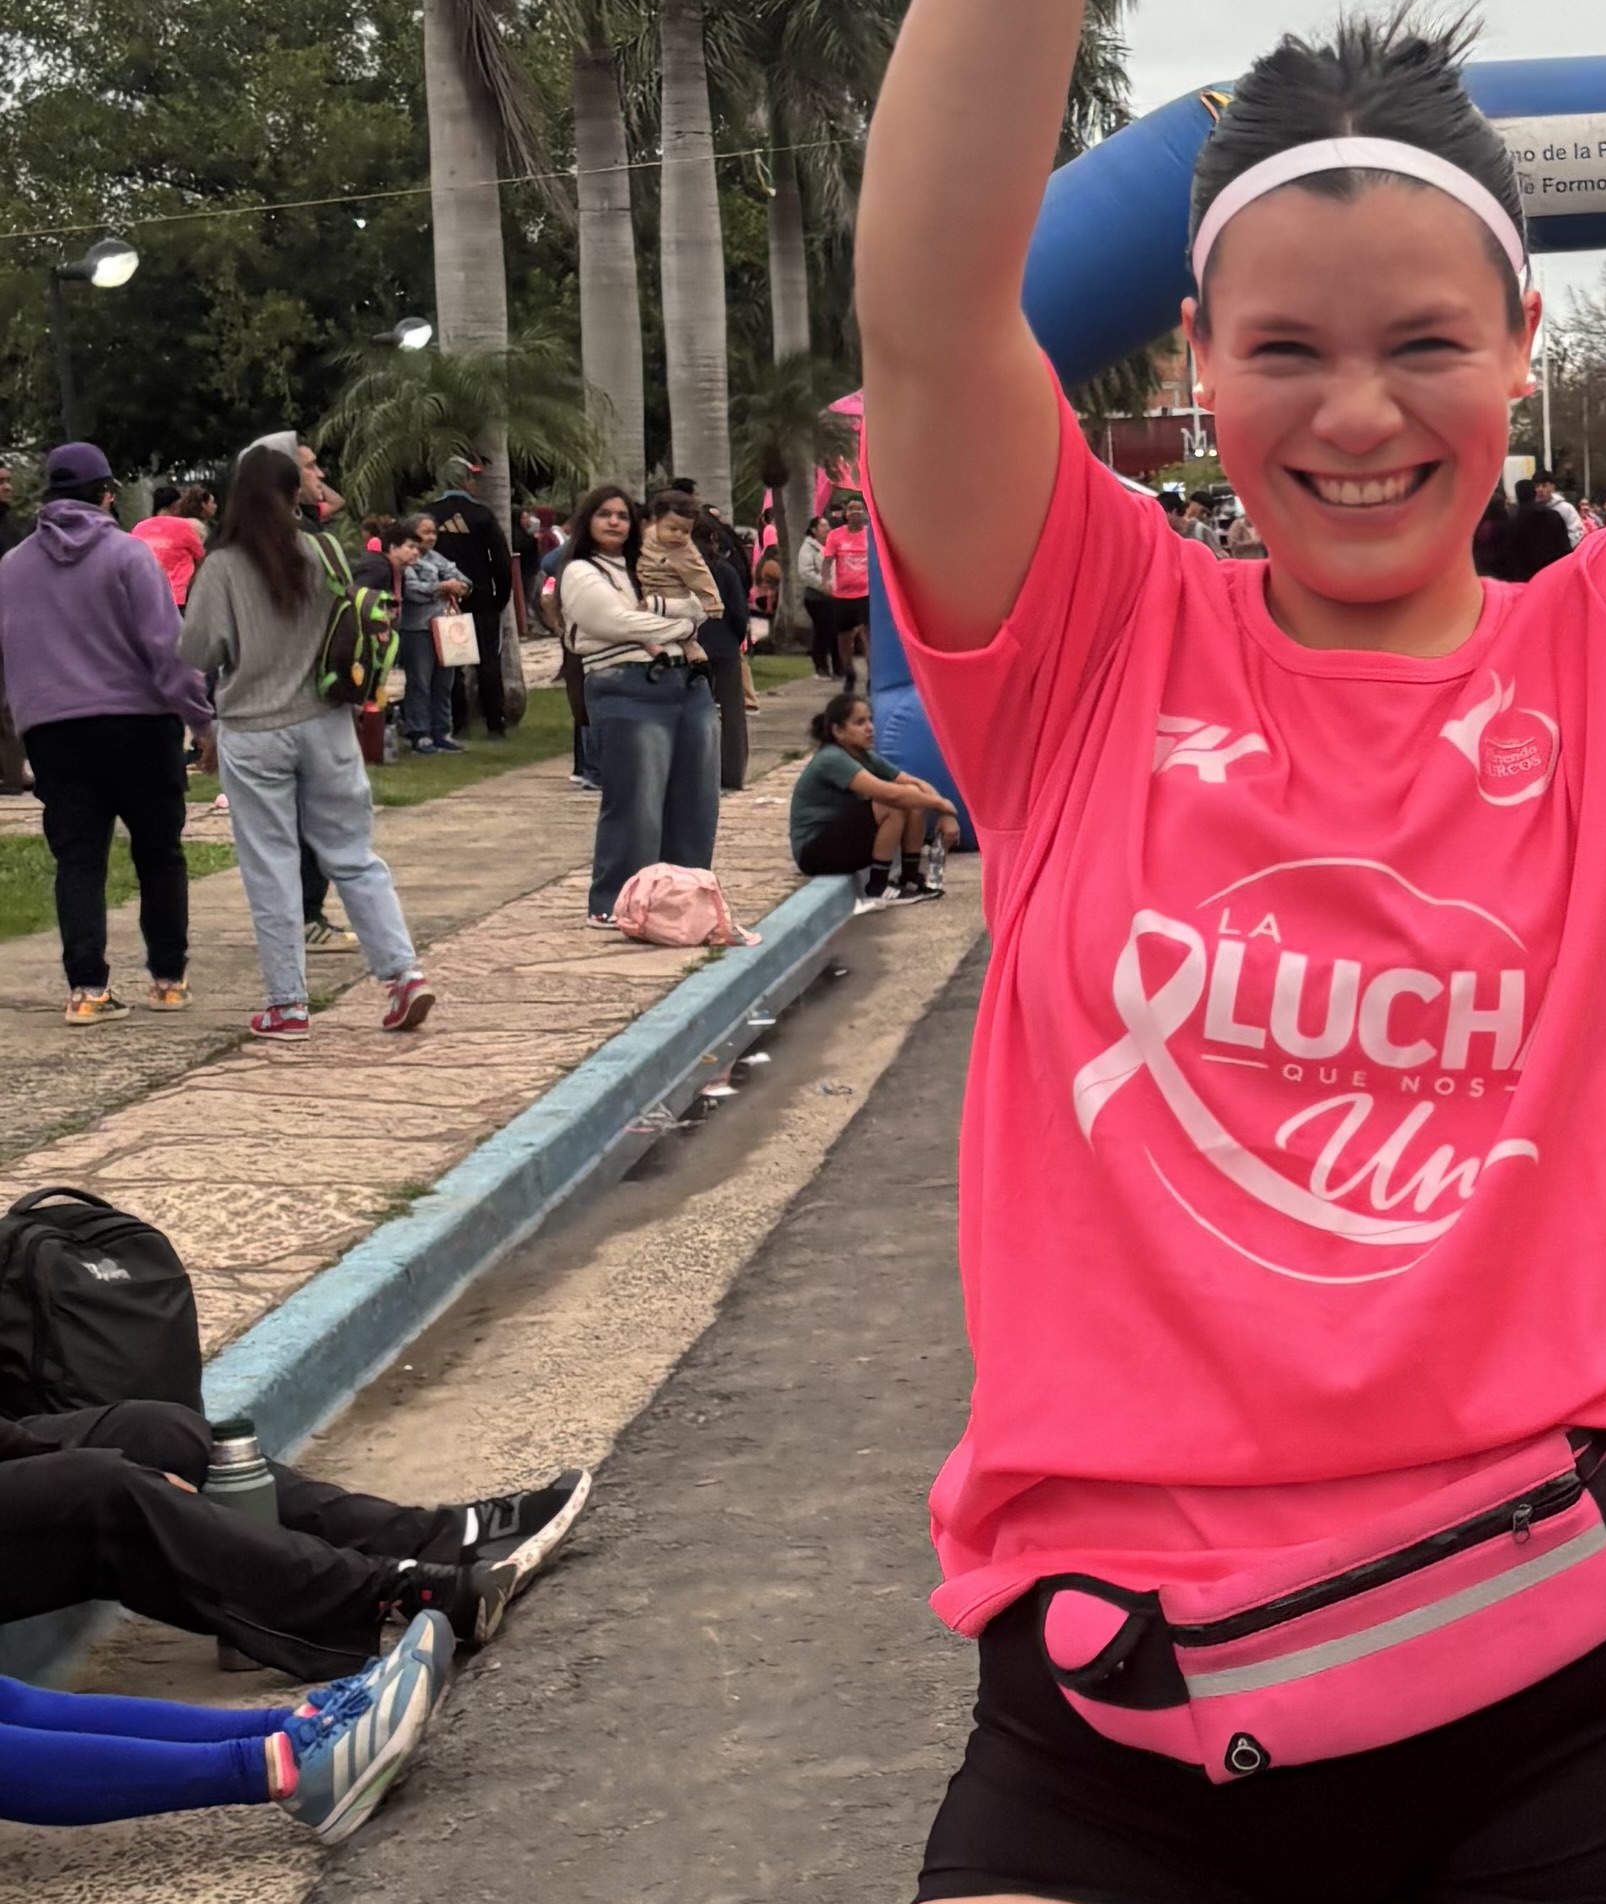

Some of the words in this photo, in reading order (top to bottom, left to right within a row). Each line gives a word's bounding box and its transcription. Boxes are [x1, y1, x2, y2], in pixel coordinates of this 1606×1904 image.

[1543, 143, 1567, 161] de
[1574, 142, 1591, 160] la
[1218, 907, 1282, 943] LA
[1203, 938, 1528, 1071] LUCH
[1282, 1063, 1367, 1088] QUE
[1401, 1076, 1485, 1097] NOS
[1275, 1092, 1481, 1213] Un
